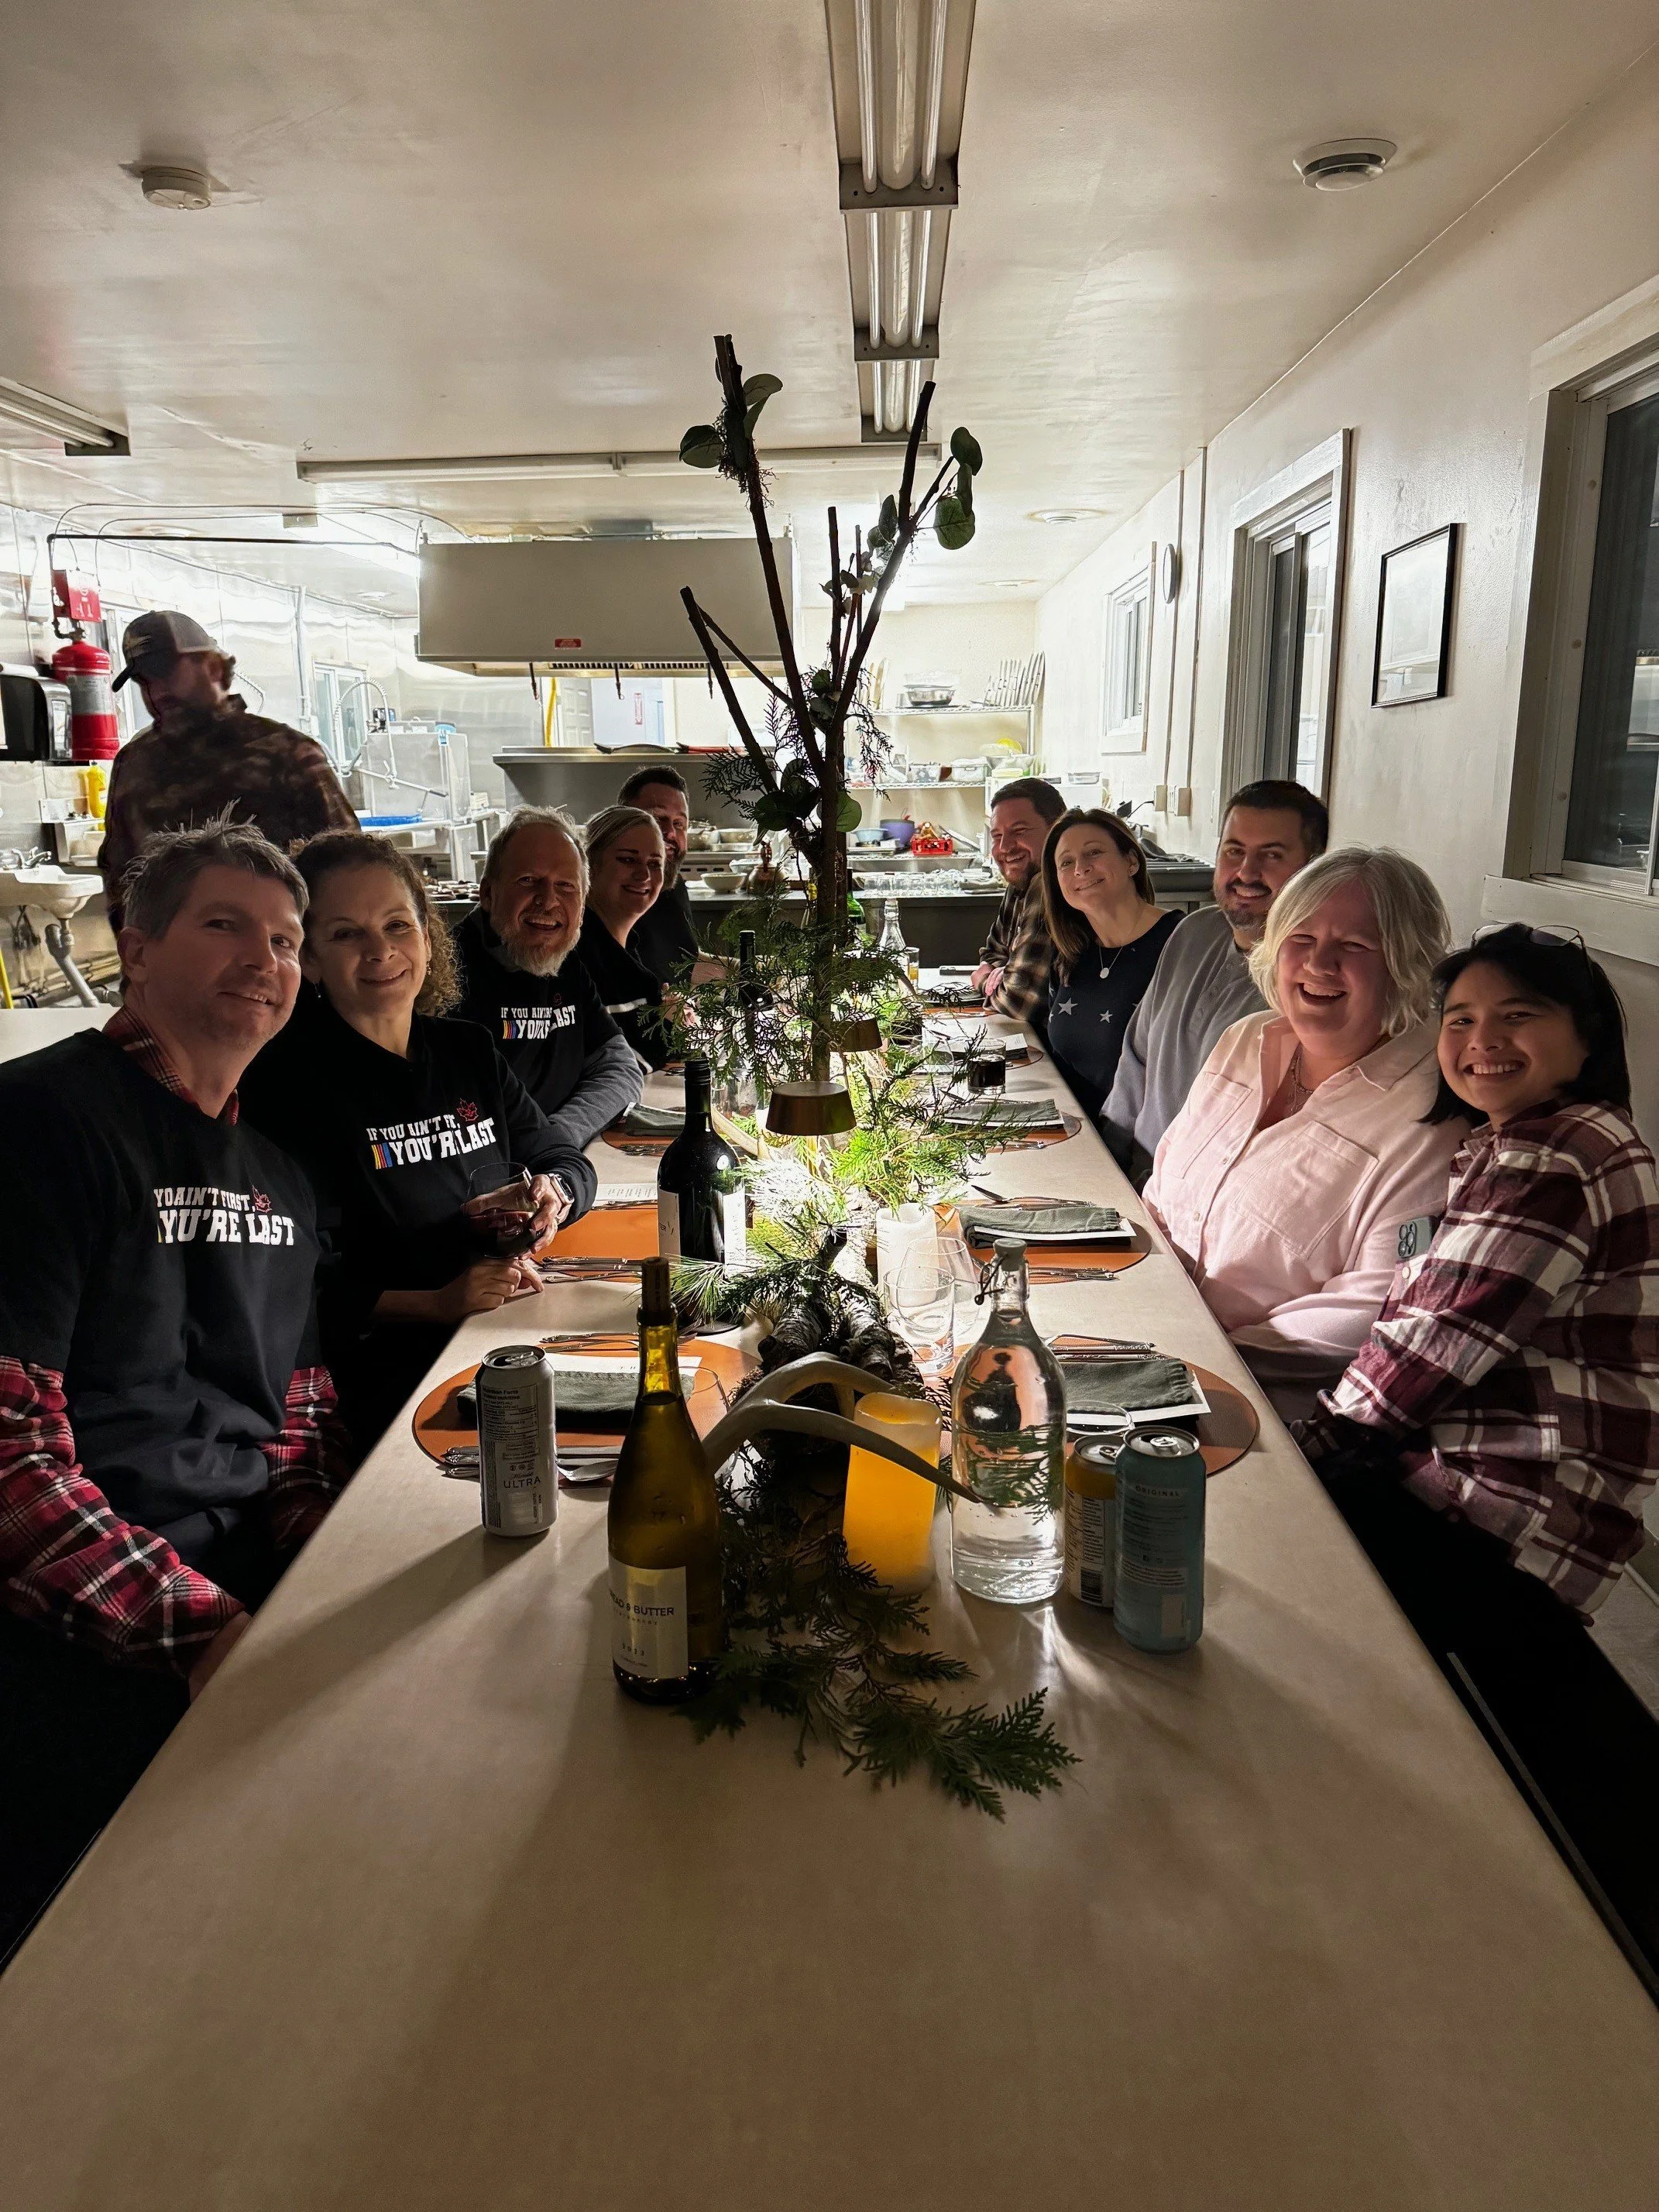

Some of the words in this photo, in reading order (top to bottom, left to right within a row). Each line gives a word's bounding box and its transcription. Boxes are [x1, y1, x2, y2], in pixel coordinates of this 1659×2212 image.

[501, 1007, 509, 1018] IF
[511, 1008, 528, 1018] YOU
[366, 1128, 378, 1141] IF
[380, 1123, 405, 1141] YOU
[407, 1115, 441, 1137] AIN'T
[389, 1130, 460, 1166] YOU'R
[456, 1117, 497, 1155] LAST
[245, 1213, 295, 1246] LAST
[503, 1476, 541, 1489] ULTRA
[1135, 1486, 1180, 1496] ORIGINAL
[634, 1605, 675, 1616] BUTTER
